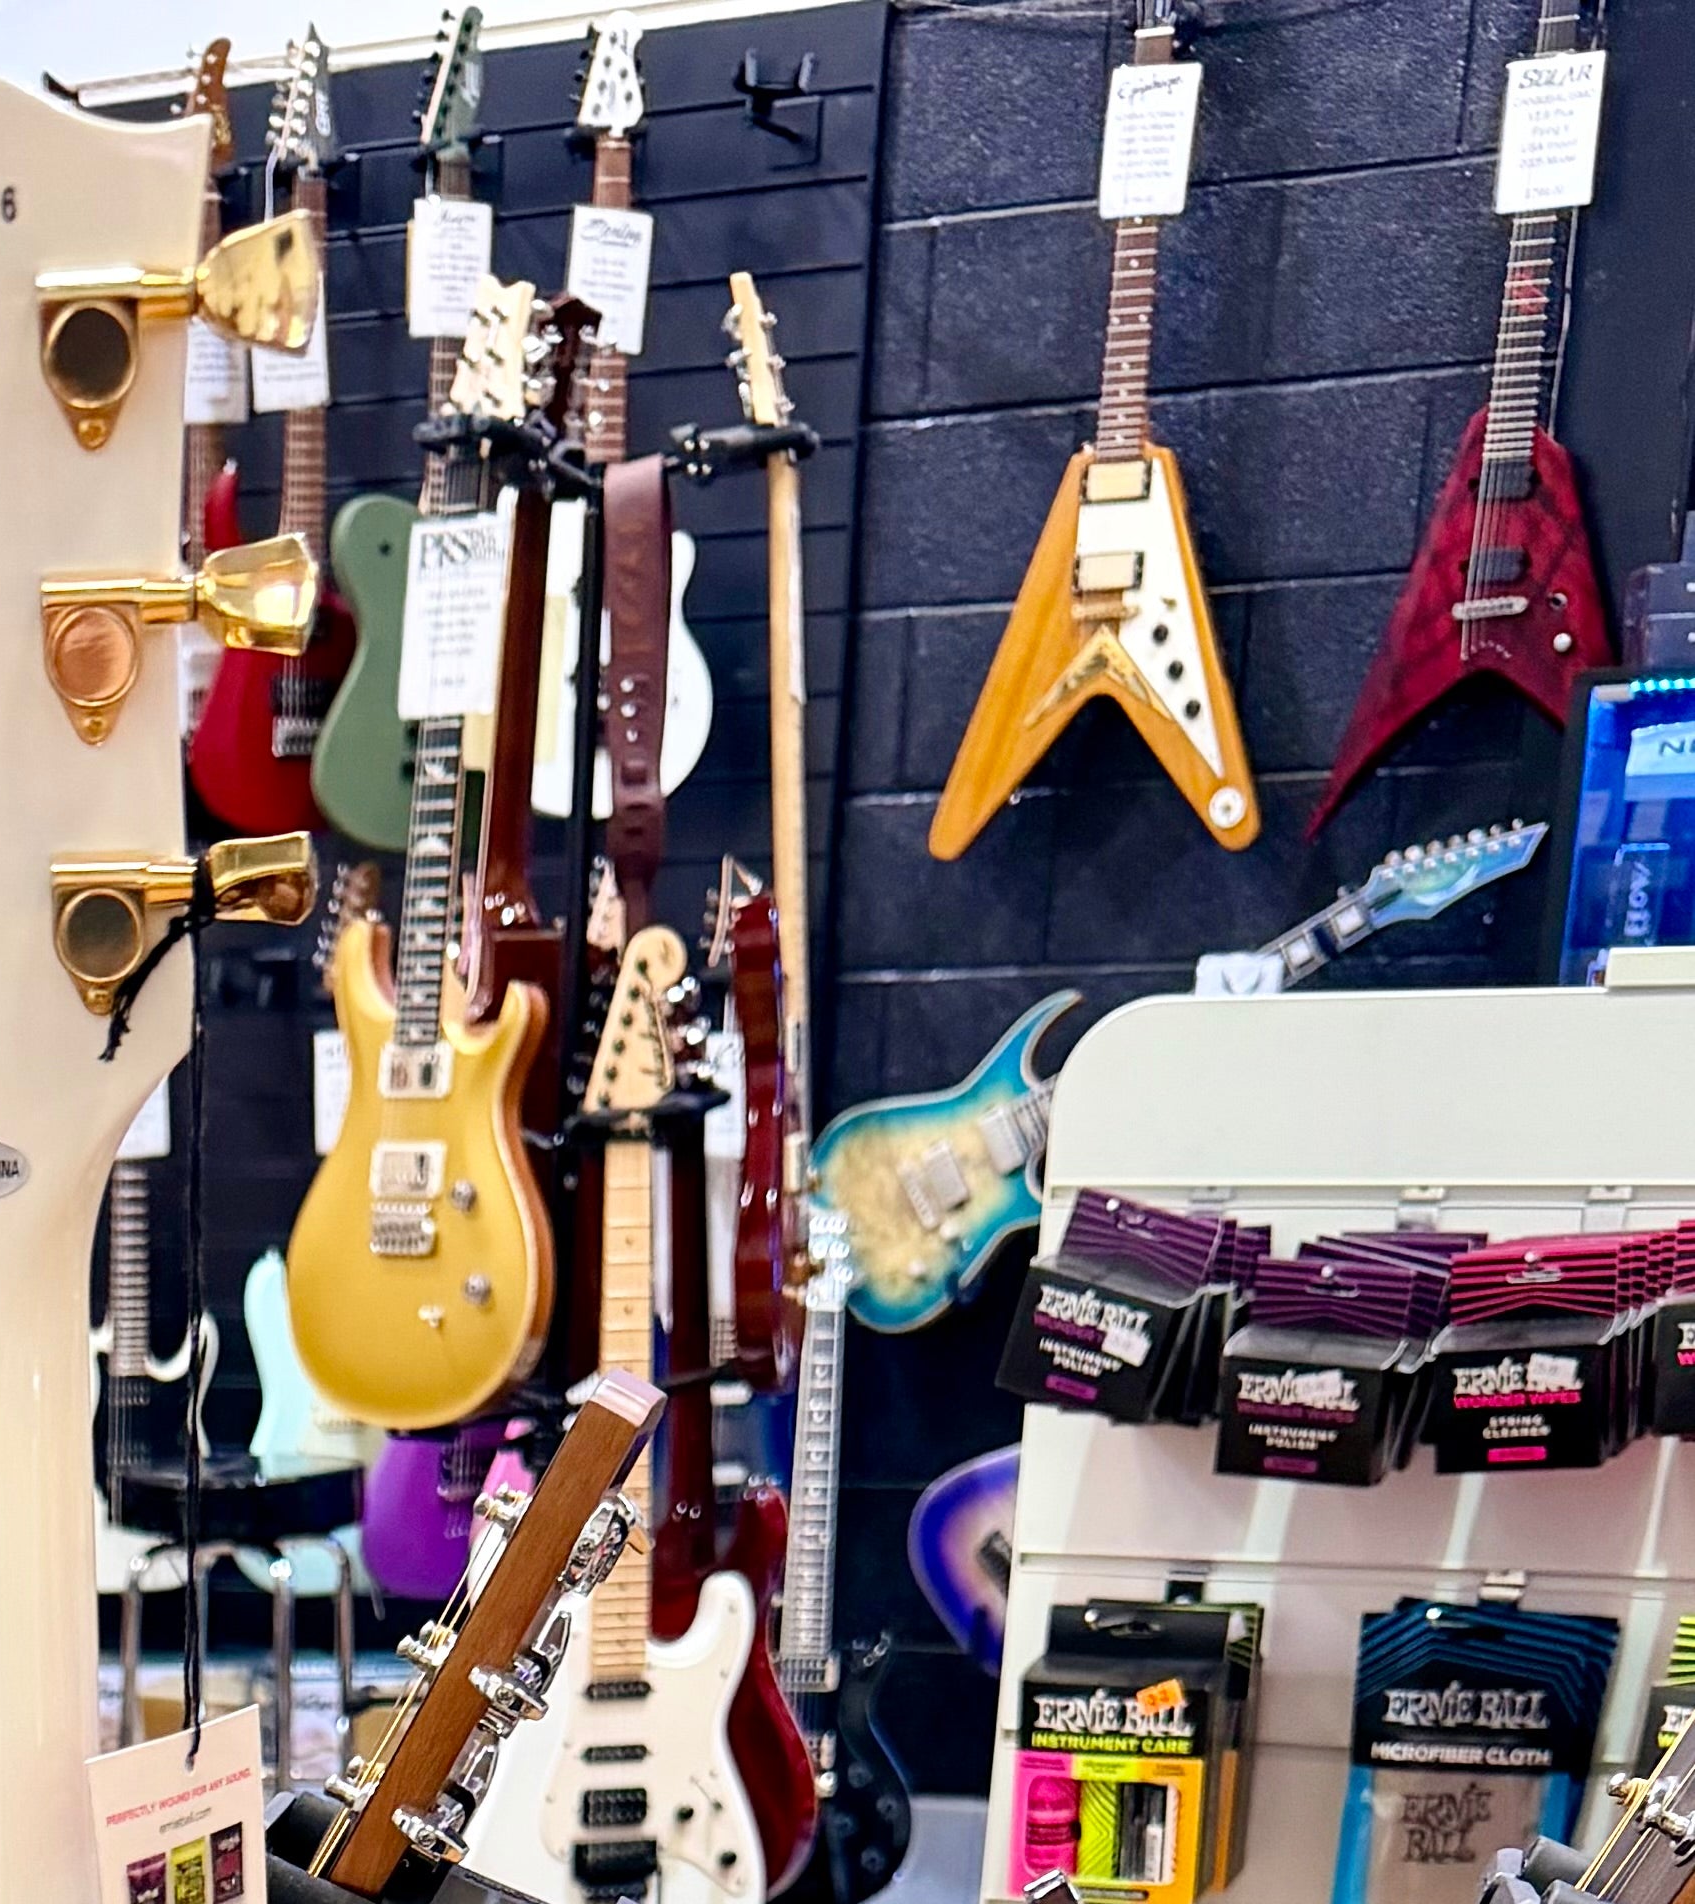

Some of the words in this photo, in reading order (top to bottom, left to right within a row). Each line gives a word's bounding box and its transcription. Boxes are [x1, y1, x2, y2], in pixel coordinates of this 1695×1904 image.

[1033, 1687, 1123, 1735] ERNIE
[1382, 1680, 1476, 1728] ERNIE
[1473, 1688, 1550, 1729] BALL
[1031, 1731, 1140, 1752] INSTRUMENT
[1142, 1737, 1193, 1755] CARE
[1370, 1741, 1485, 1765] MICROFIBER
[1485, 1747, 1554, 1767] CLOTH
[1402, 1781, 1493, 1832] ERNIE
[1403, 1825, 1476, 1864] BALL
